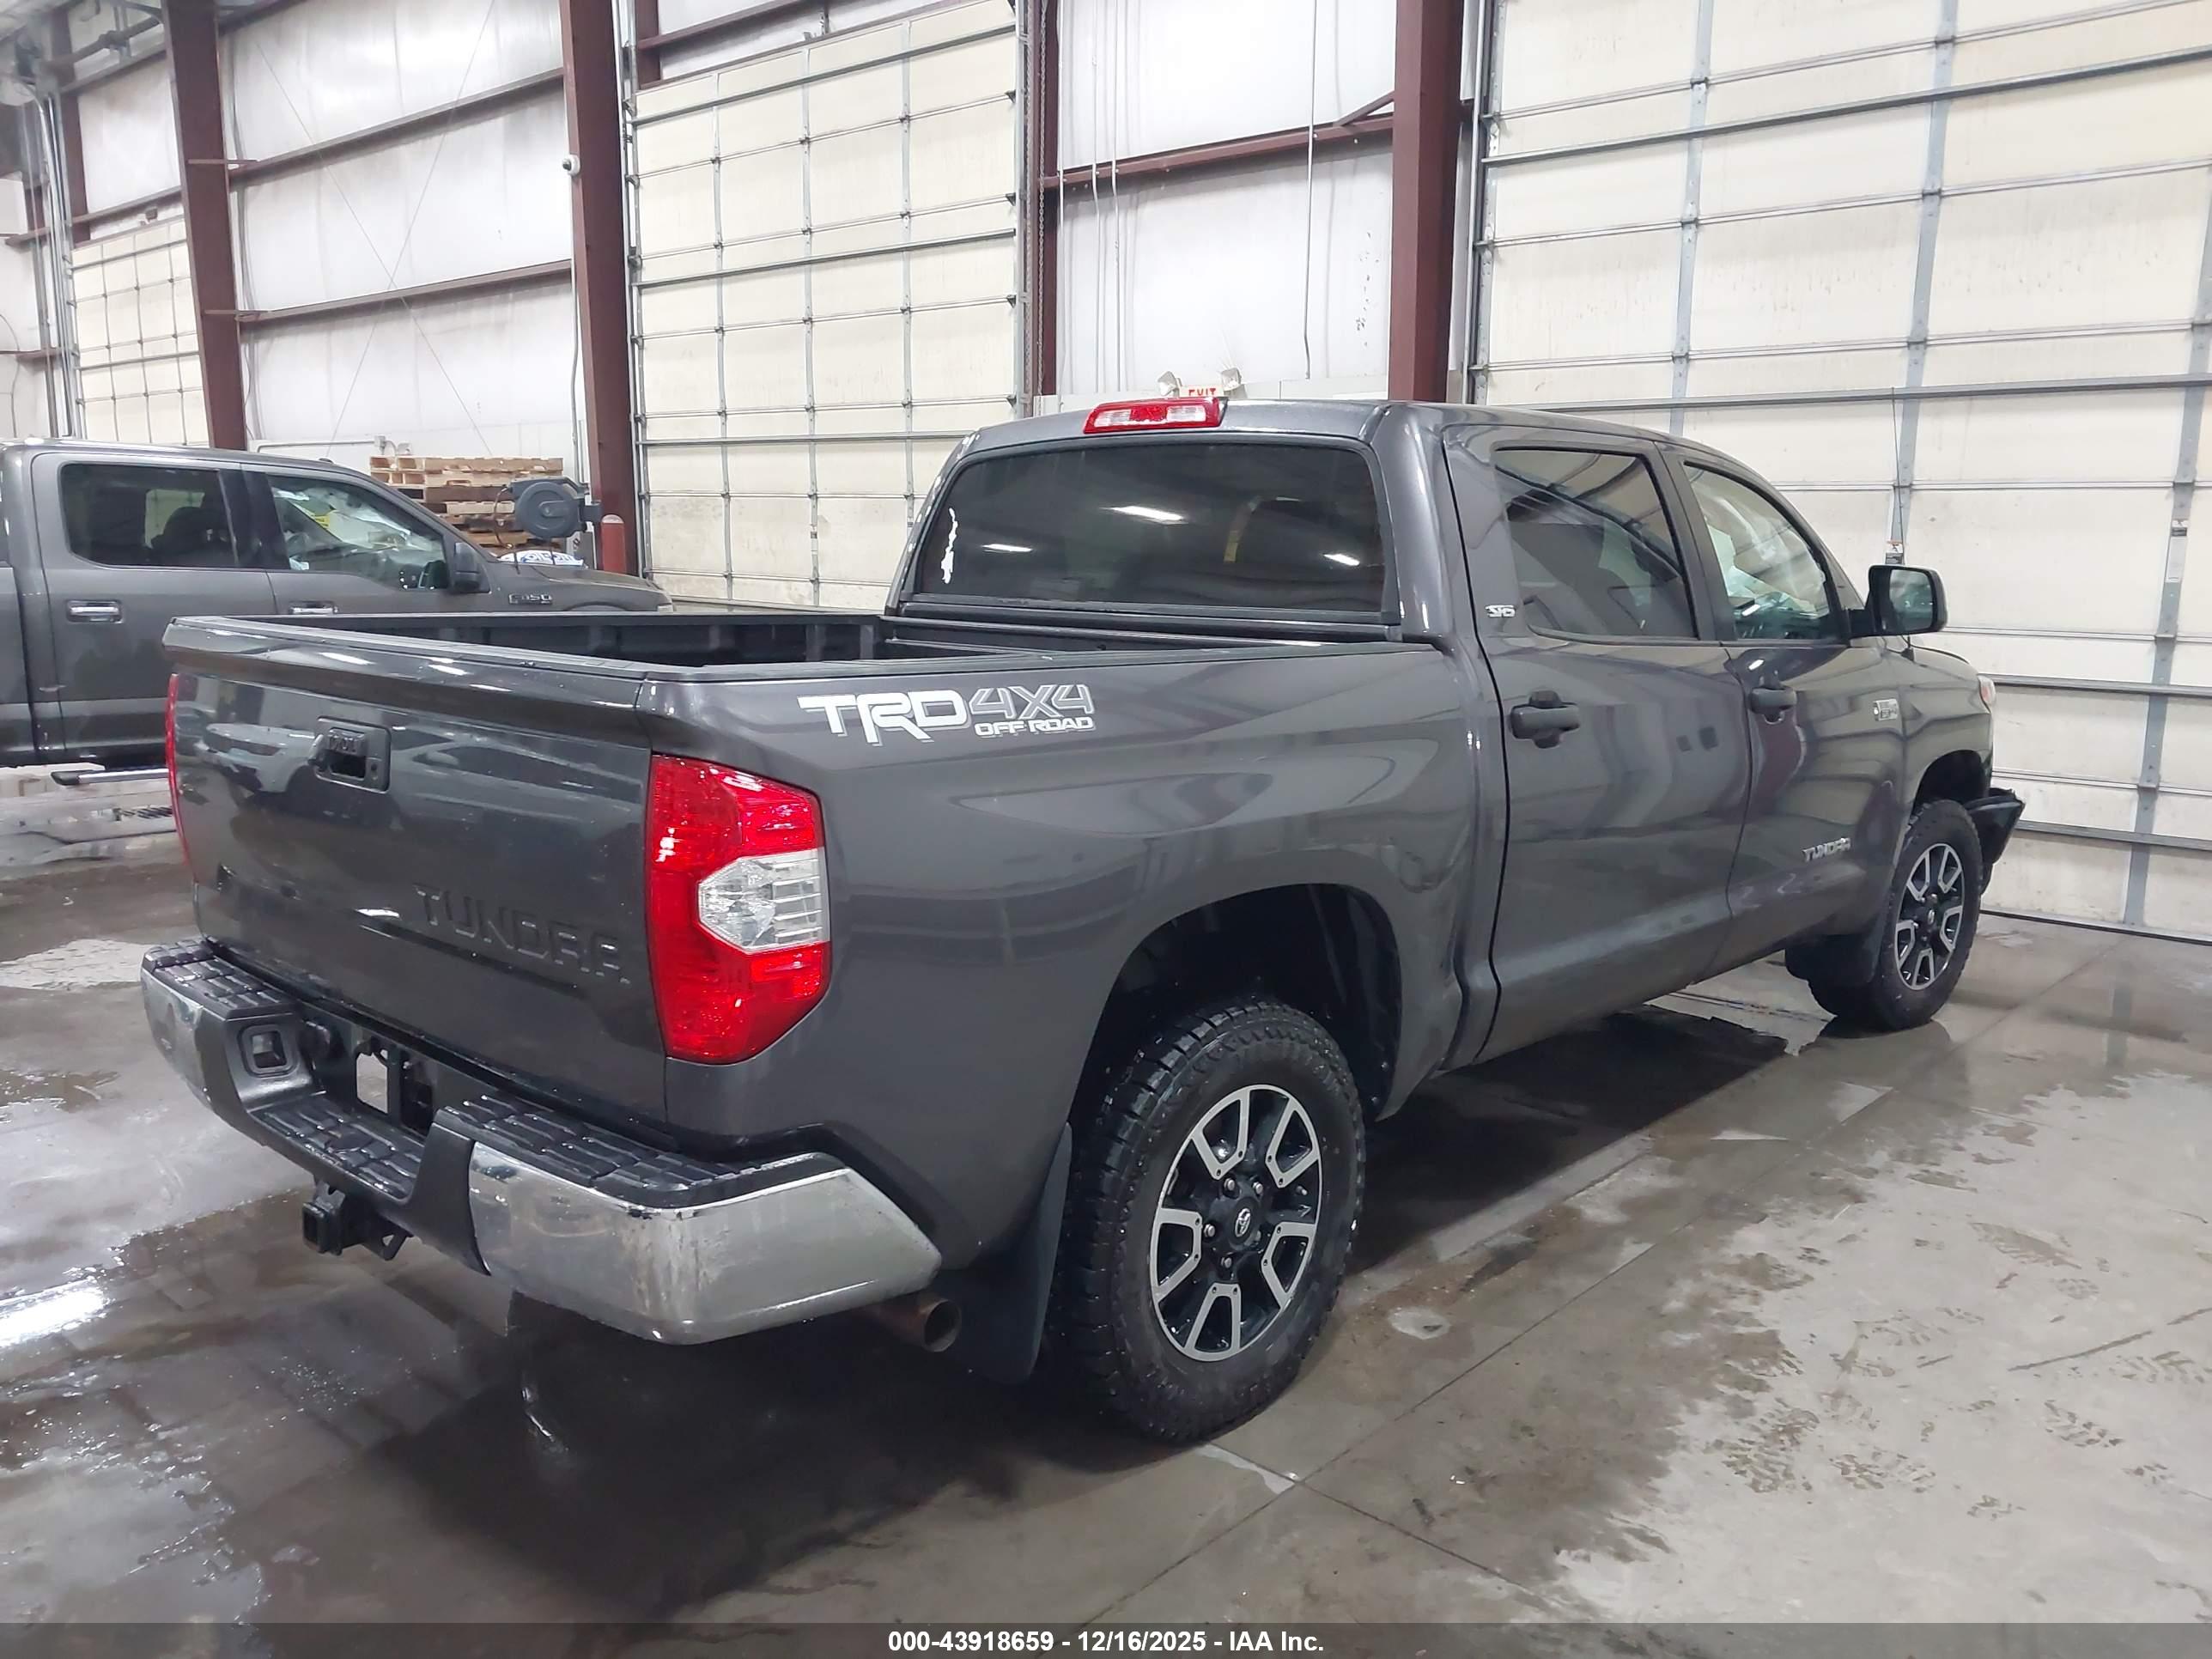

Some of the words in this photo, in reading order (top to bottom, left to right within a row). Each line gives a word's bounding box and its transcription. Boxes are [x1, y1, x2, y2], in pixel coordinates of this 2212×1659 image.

[797, 690, 971, 746] TRD
[969, 684, 1096, 720] 4X4
[974, 720, 1026, 738] OFF
[1029, 716, 1097, 734] ROAD
[412, 882, 631, 985] TUNDRA
